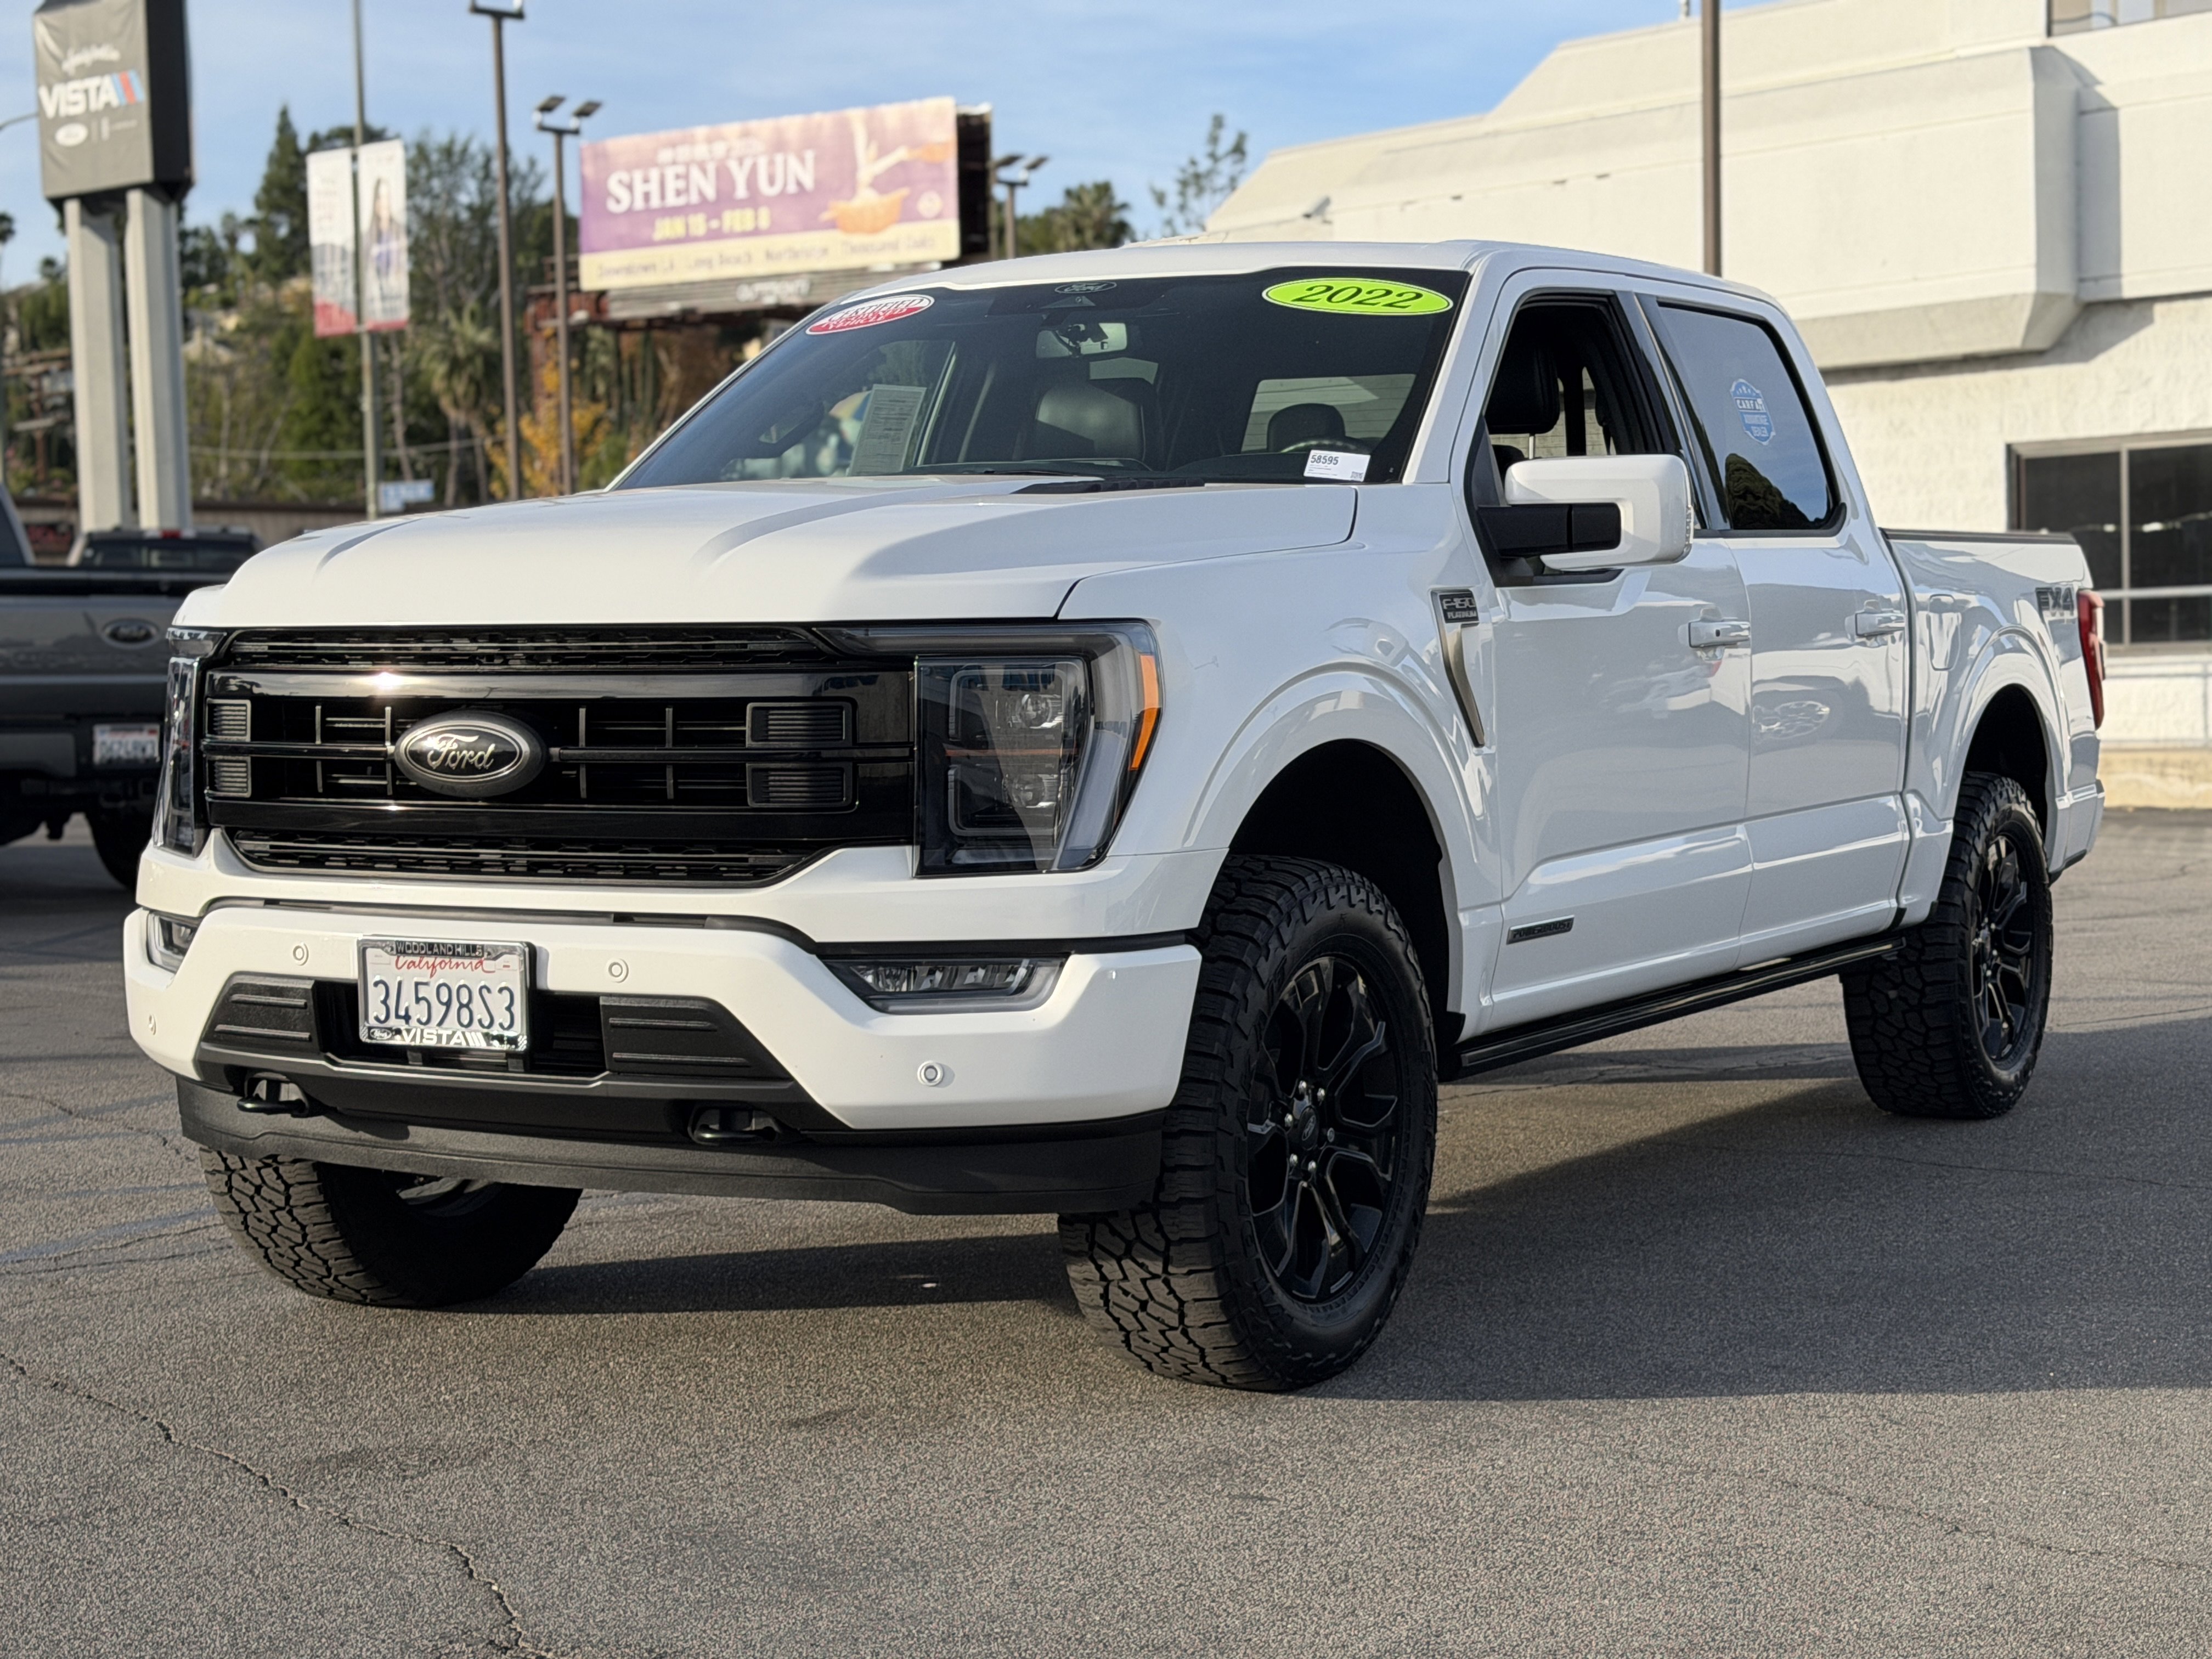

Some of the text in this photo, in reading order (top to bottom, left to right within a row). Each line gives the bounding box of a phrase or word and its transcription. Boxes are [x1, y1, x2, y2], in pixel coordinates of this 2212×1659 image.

[38, 75, 121, 119] VISTA
[606, 161, 716, 214] SHEN
[726, 148, 816, 200] YUN
[1291, 284, 1424, 309] 2022
[828, 298, 924, 323] CERTIFIED
[1310, 454, 1340, 466] 58595
[426, 733, 495, 770] Ford
[396, 941, 483, 957] WOODLAND HILLS
[394, 955, 496, 979] California
[373, 978, 515, 1031] 34598S3
[401, 1027, 470, 1046] VISTA
